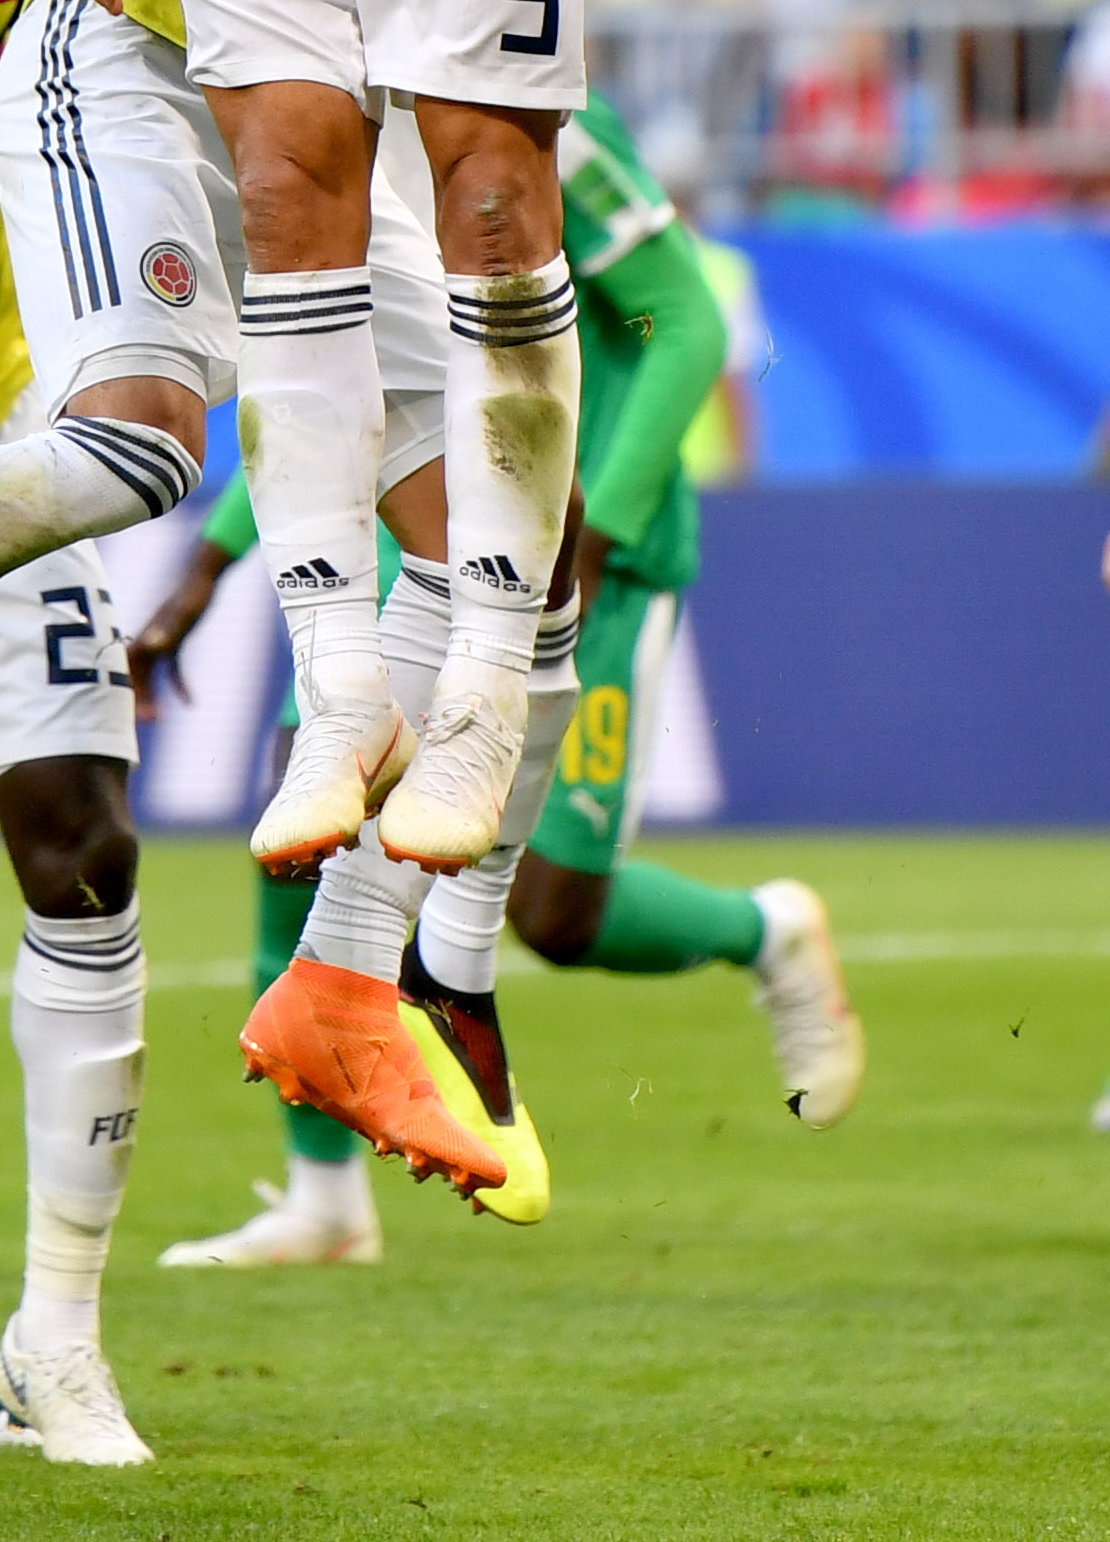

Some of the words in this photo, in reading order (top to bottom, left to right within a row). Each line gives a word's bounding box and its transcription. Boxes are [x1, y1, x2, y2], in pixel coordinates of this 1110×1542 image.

[276, 576, 350, 589] adidas
[459, 564, 532, 594] adidas
[561, 684, 629, 785] 19
